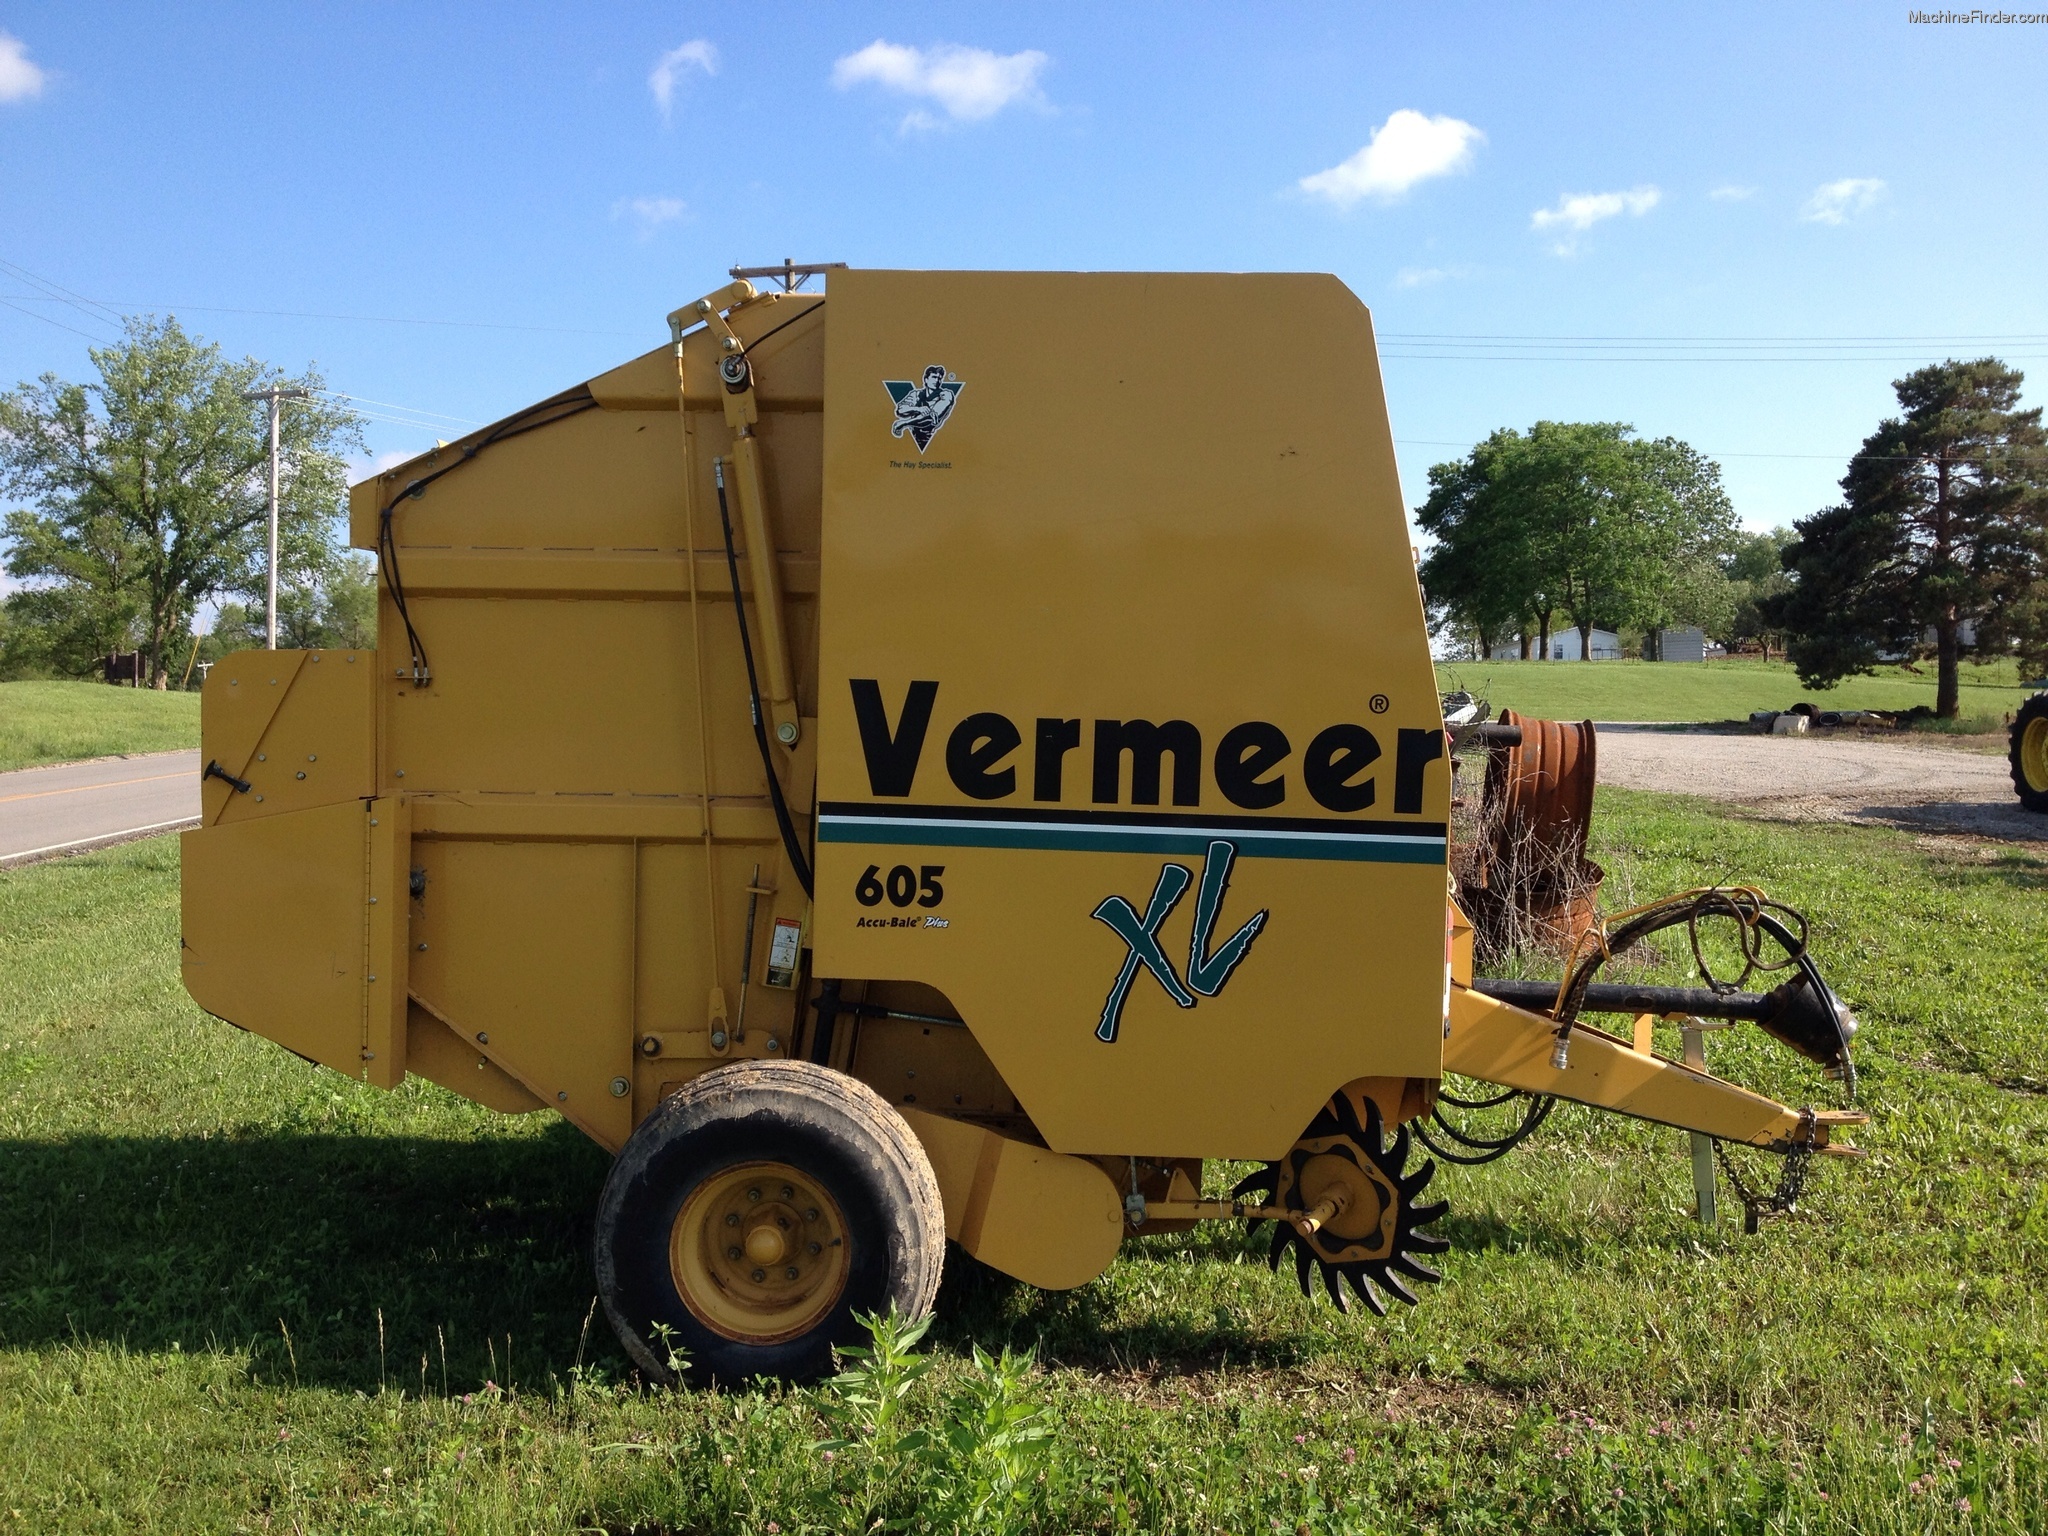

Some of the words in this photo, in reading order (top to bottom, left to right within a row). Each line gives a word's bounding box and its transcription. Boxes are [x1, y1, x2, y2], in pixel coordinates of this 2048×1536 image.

[889, 460, 902, 469] The
[903, 460, 917, 470] Hay
[848, 678, 1444, 814] Vermeer
[855, 864, 945, 908] 605
[923, 916, 950, 929] Plus
[1090, 840, 1269, 1043] XL
